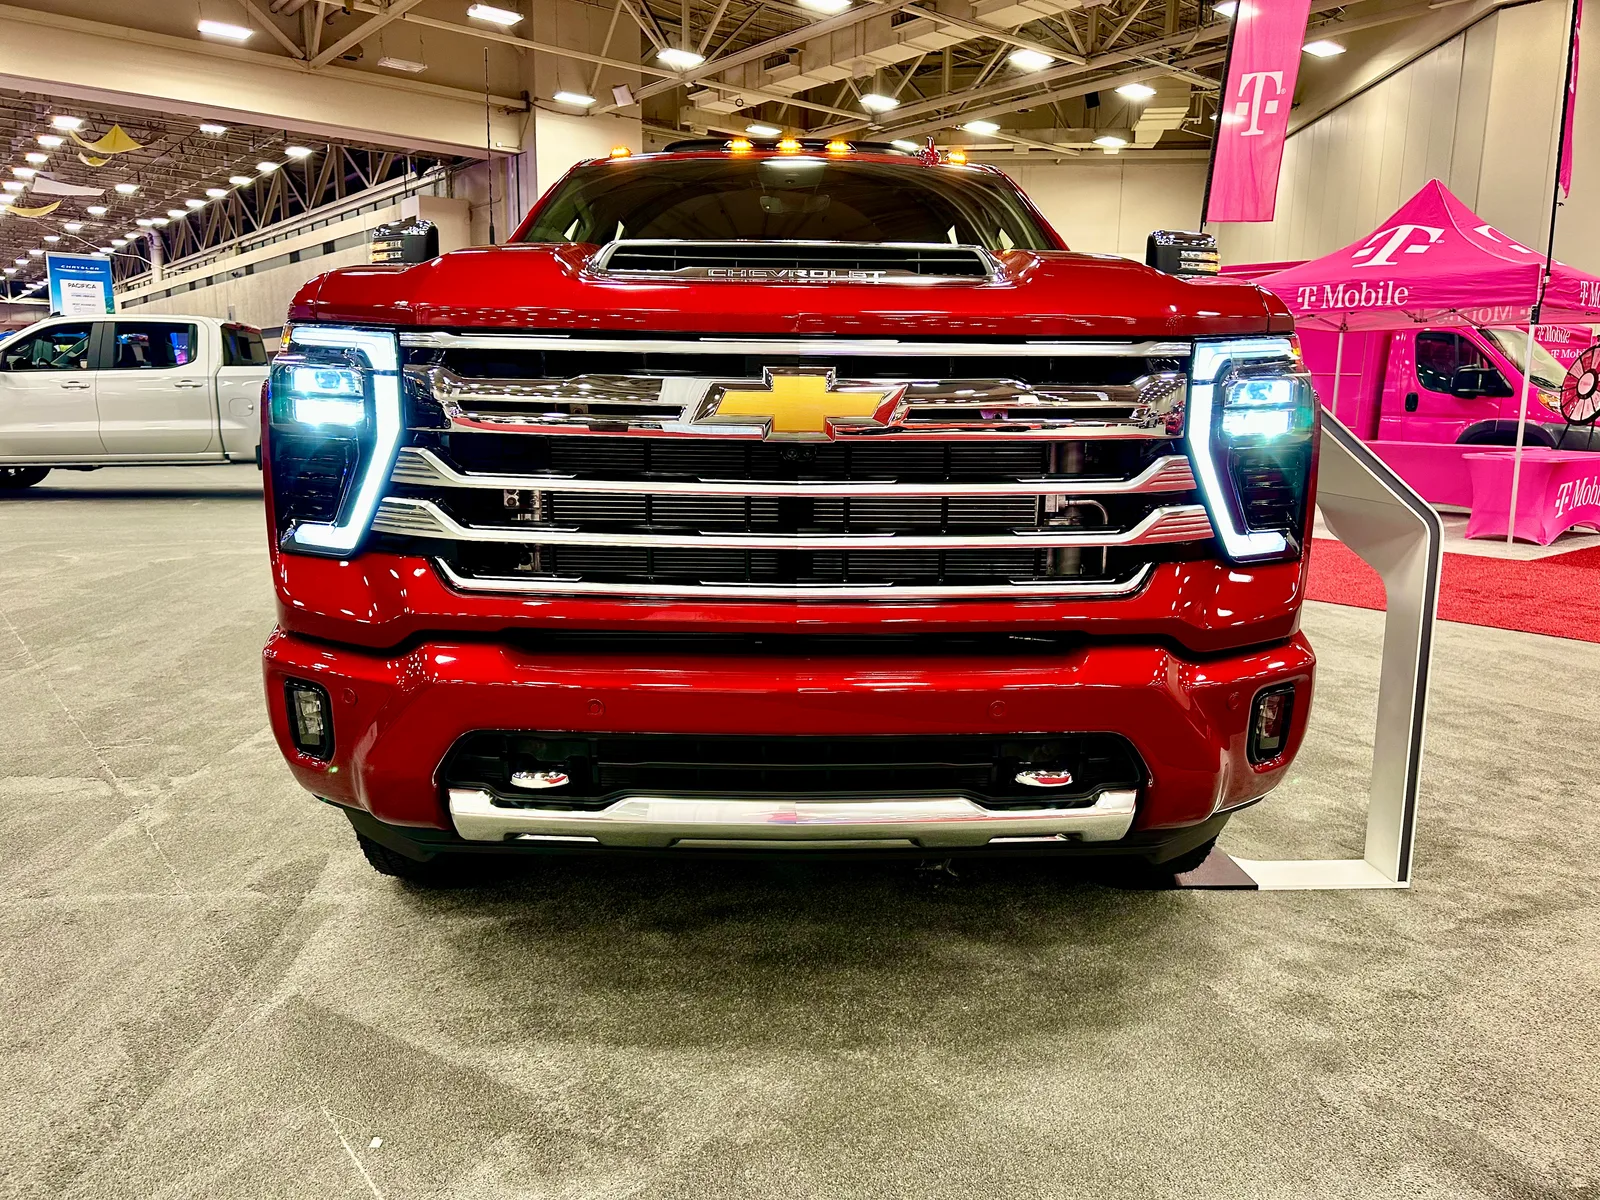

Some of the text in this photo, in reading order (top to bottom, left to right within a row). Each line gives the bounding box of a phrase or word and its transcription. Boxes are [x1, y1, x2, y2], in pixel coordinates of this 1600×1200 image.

[707, 269, 887, 279] CHEVROLET
[67, 282, 97, 290] PACIFICA
[1320, 280, 1409, 309] Mobile
